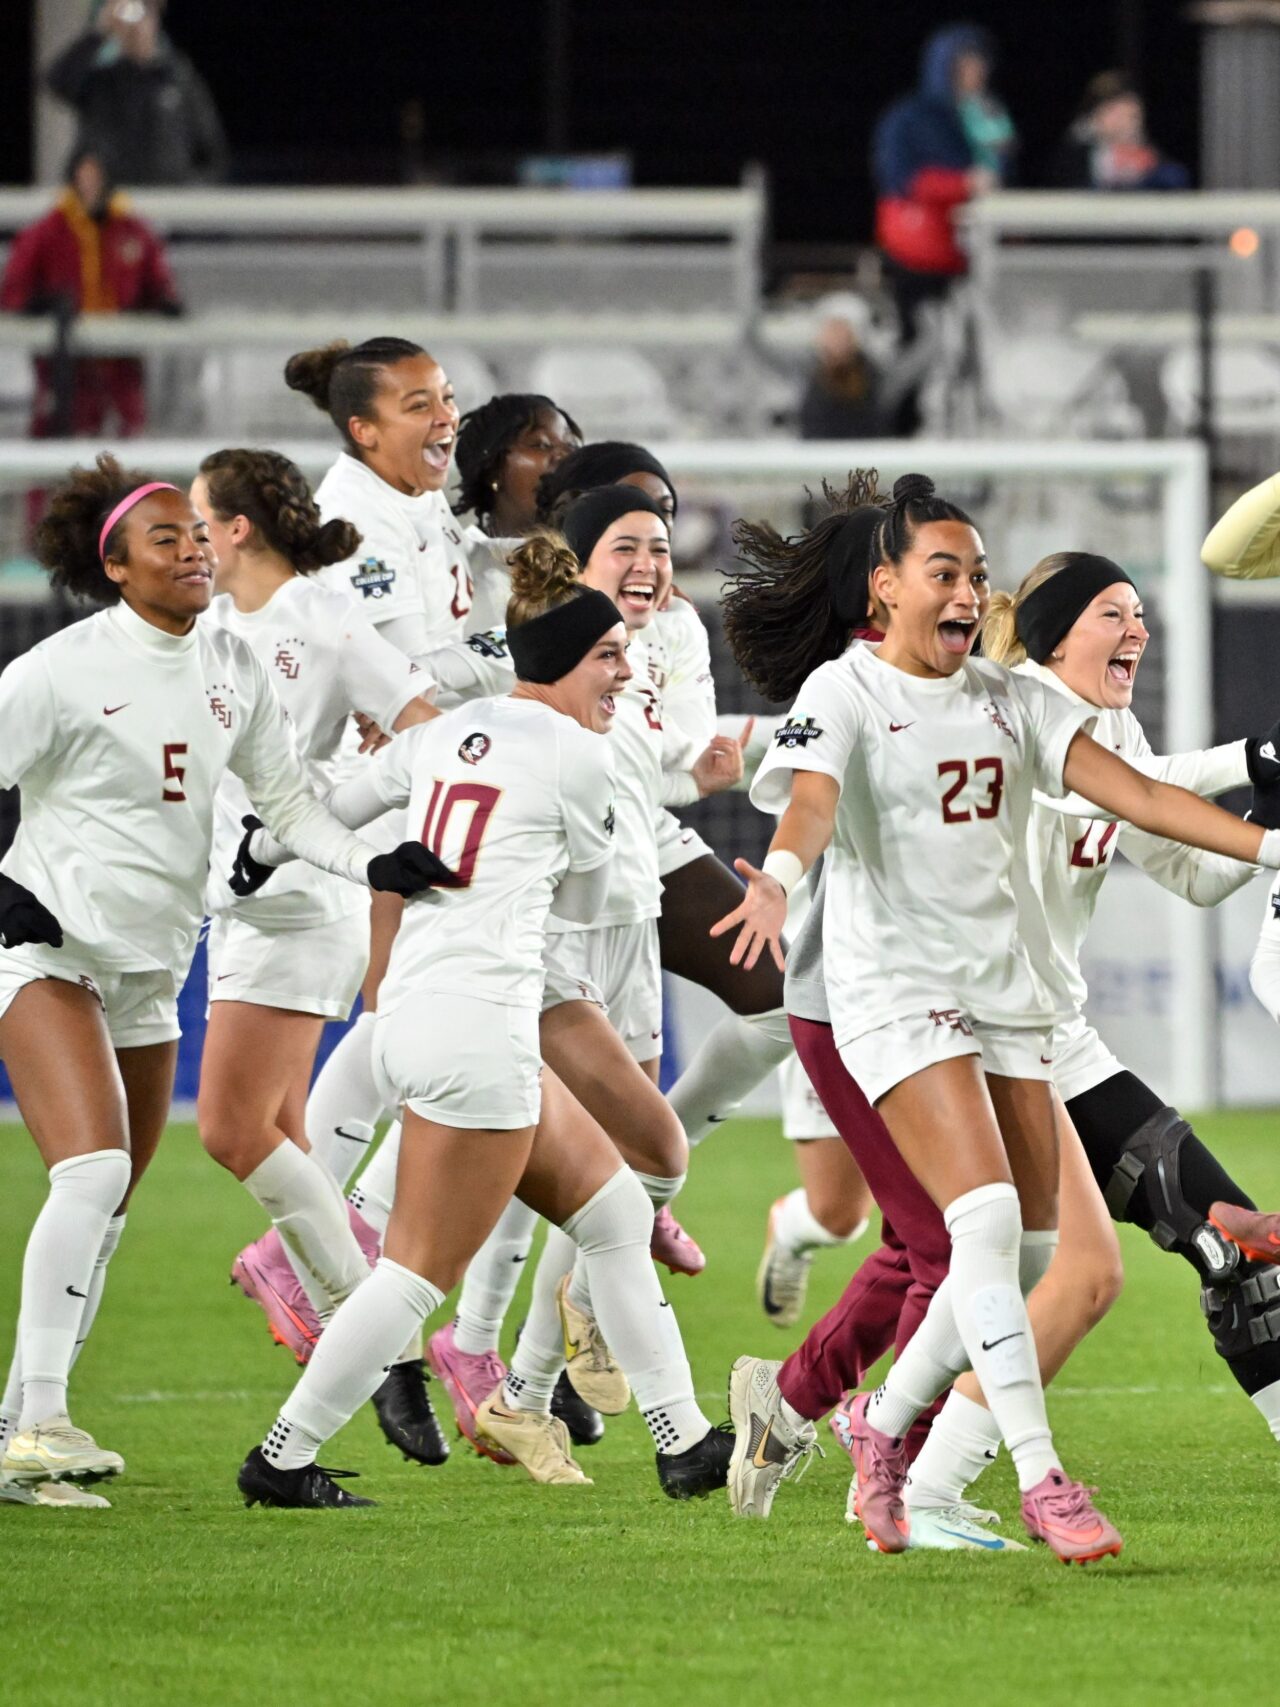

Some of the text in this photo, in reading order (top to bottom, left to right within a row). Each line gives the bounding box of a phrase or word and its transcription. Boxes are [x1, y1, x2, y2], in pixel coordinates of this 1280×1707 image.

[275, 651, 300, 679] FSU
[210, 697, 232, 729] FSU
[162, 743, 188, 802] 5
[937, 756, 1004, 825] 23
[419, 776, 506, 890] 10
